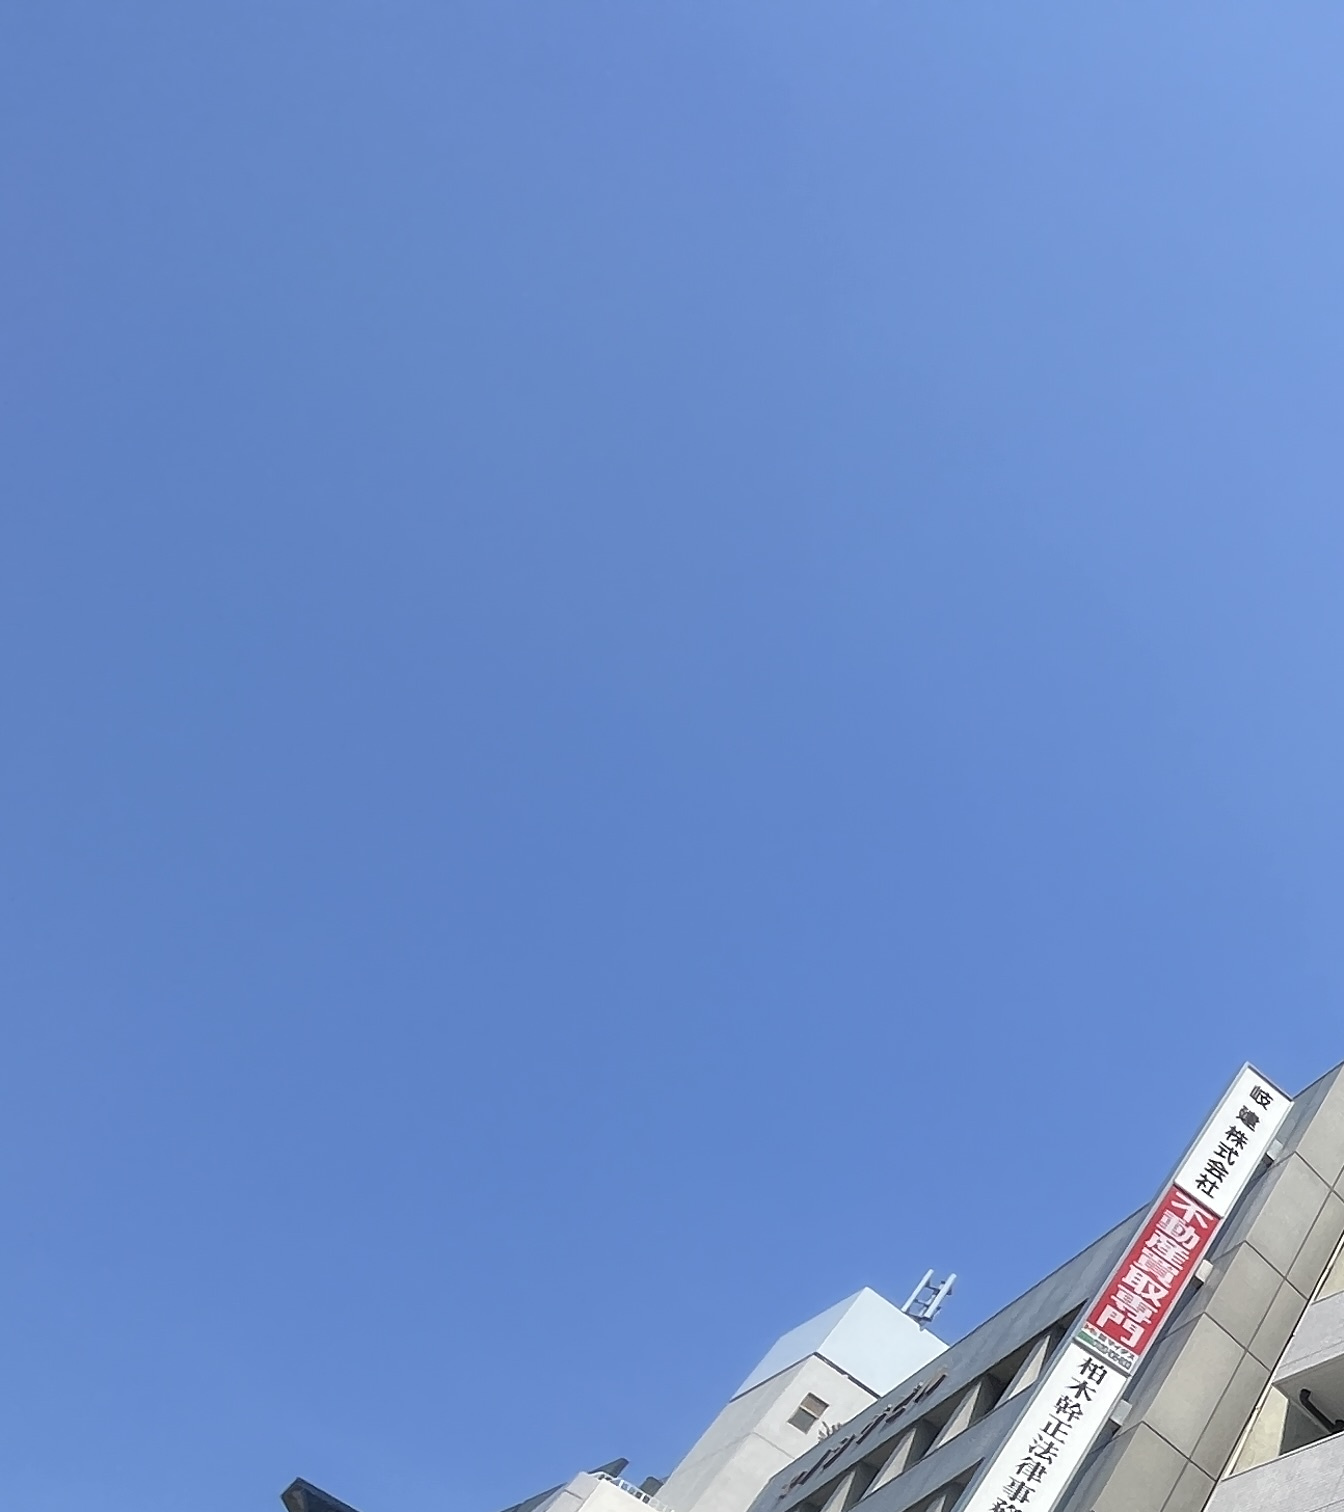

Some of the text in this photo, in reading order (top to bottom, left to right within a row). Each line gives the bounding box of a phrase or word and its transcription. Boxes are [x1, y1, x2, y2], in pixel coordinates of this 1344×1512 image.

[1096, 1191, 1214, 1348] 不動産買取専門
